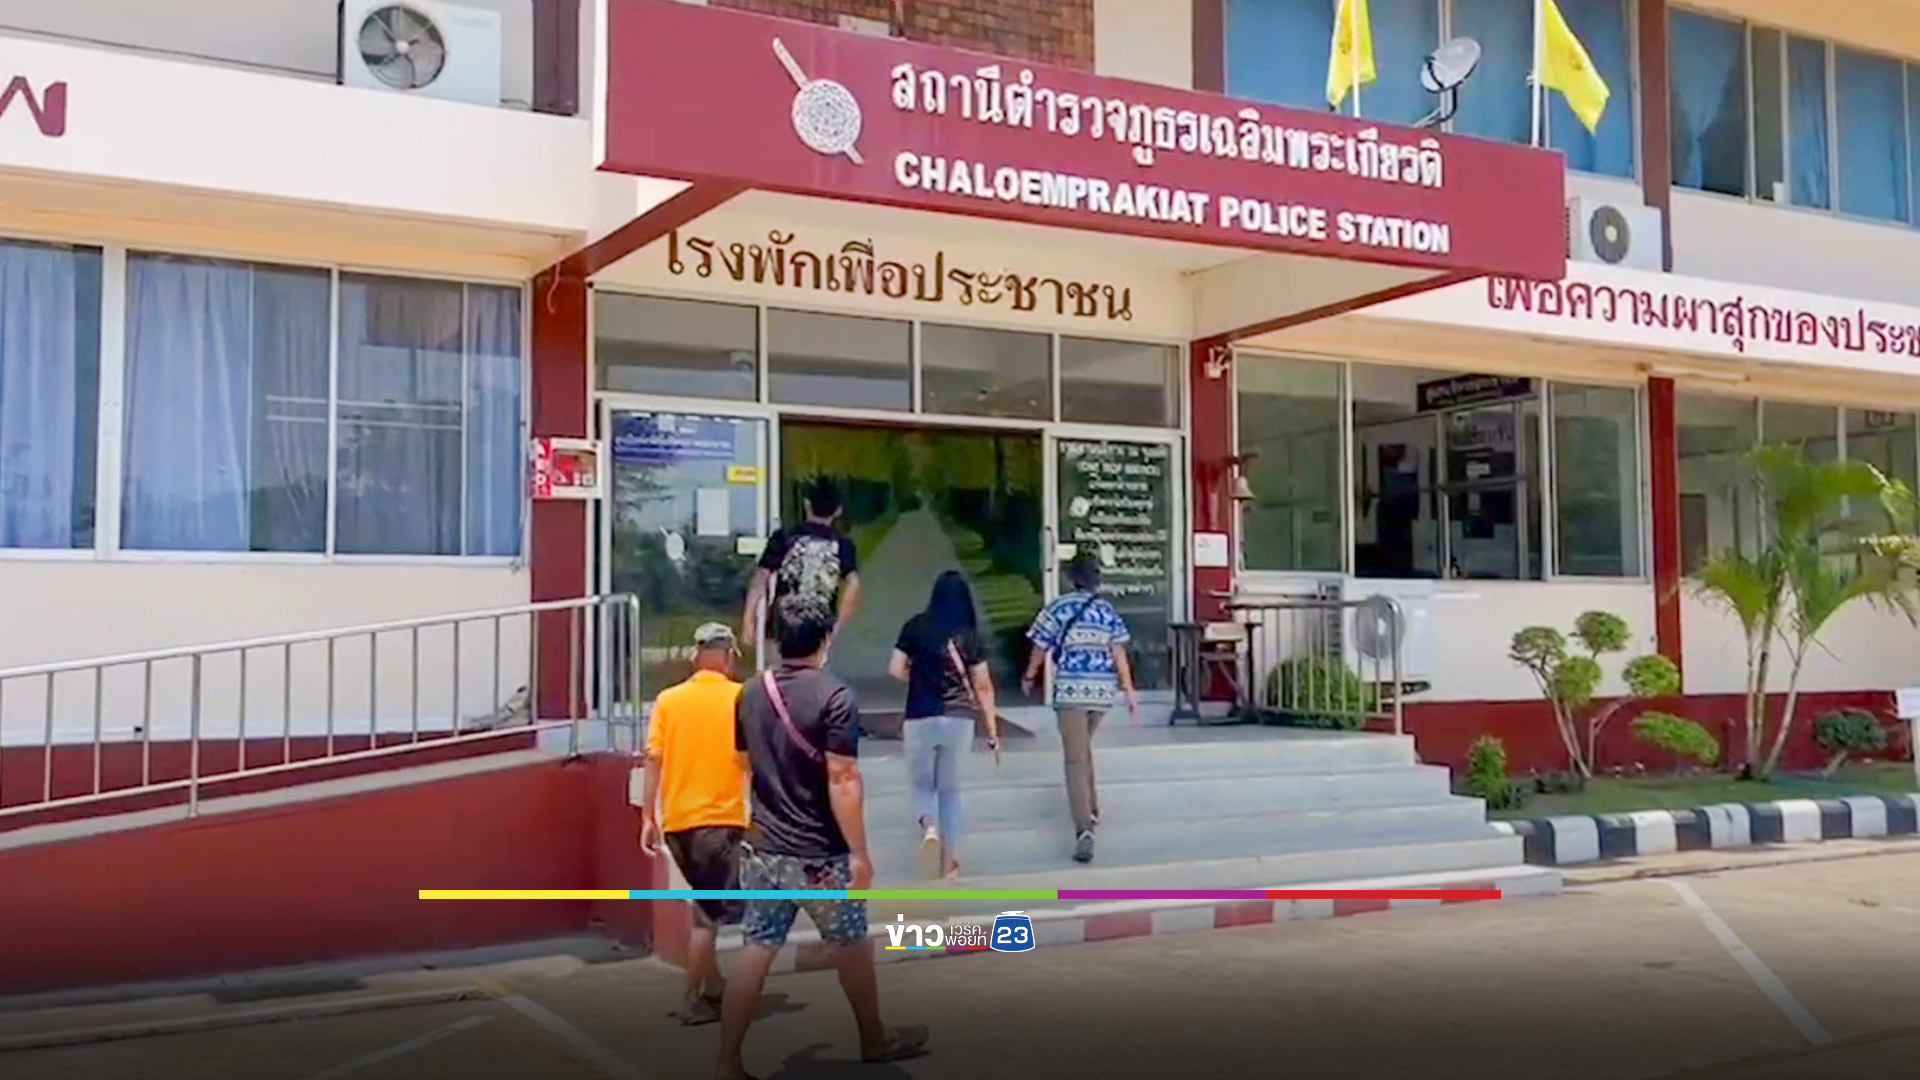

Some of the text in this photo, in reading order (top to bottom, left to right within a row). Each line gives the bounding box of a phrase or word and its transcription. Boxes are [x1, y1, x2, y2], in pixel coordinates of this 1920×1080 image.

[891, 63, 1442, 187] สถานีตำรวจภูธรเฉลิมพระเกียรติ
[895, 152, 1451, 254] CHALOEMPRAKIAT POLICE STATION
[669, 230, 1133, 321] โรงพักเพื่อประชาชน
[1488, 277, 1920, 357] เพอความผาสุกของประช
